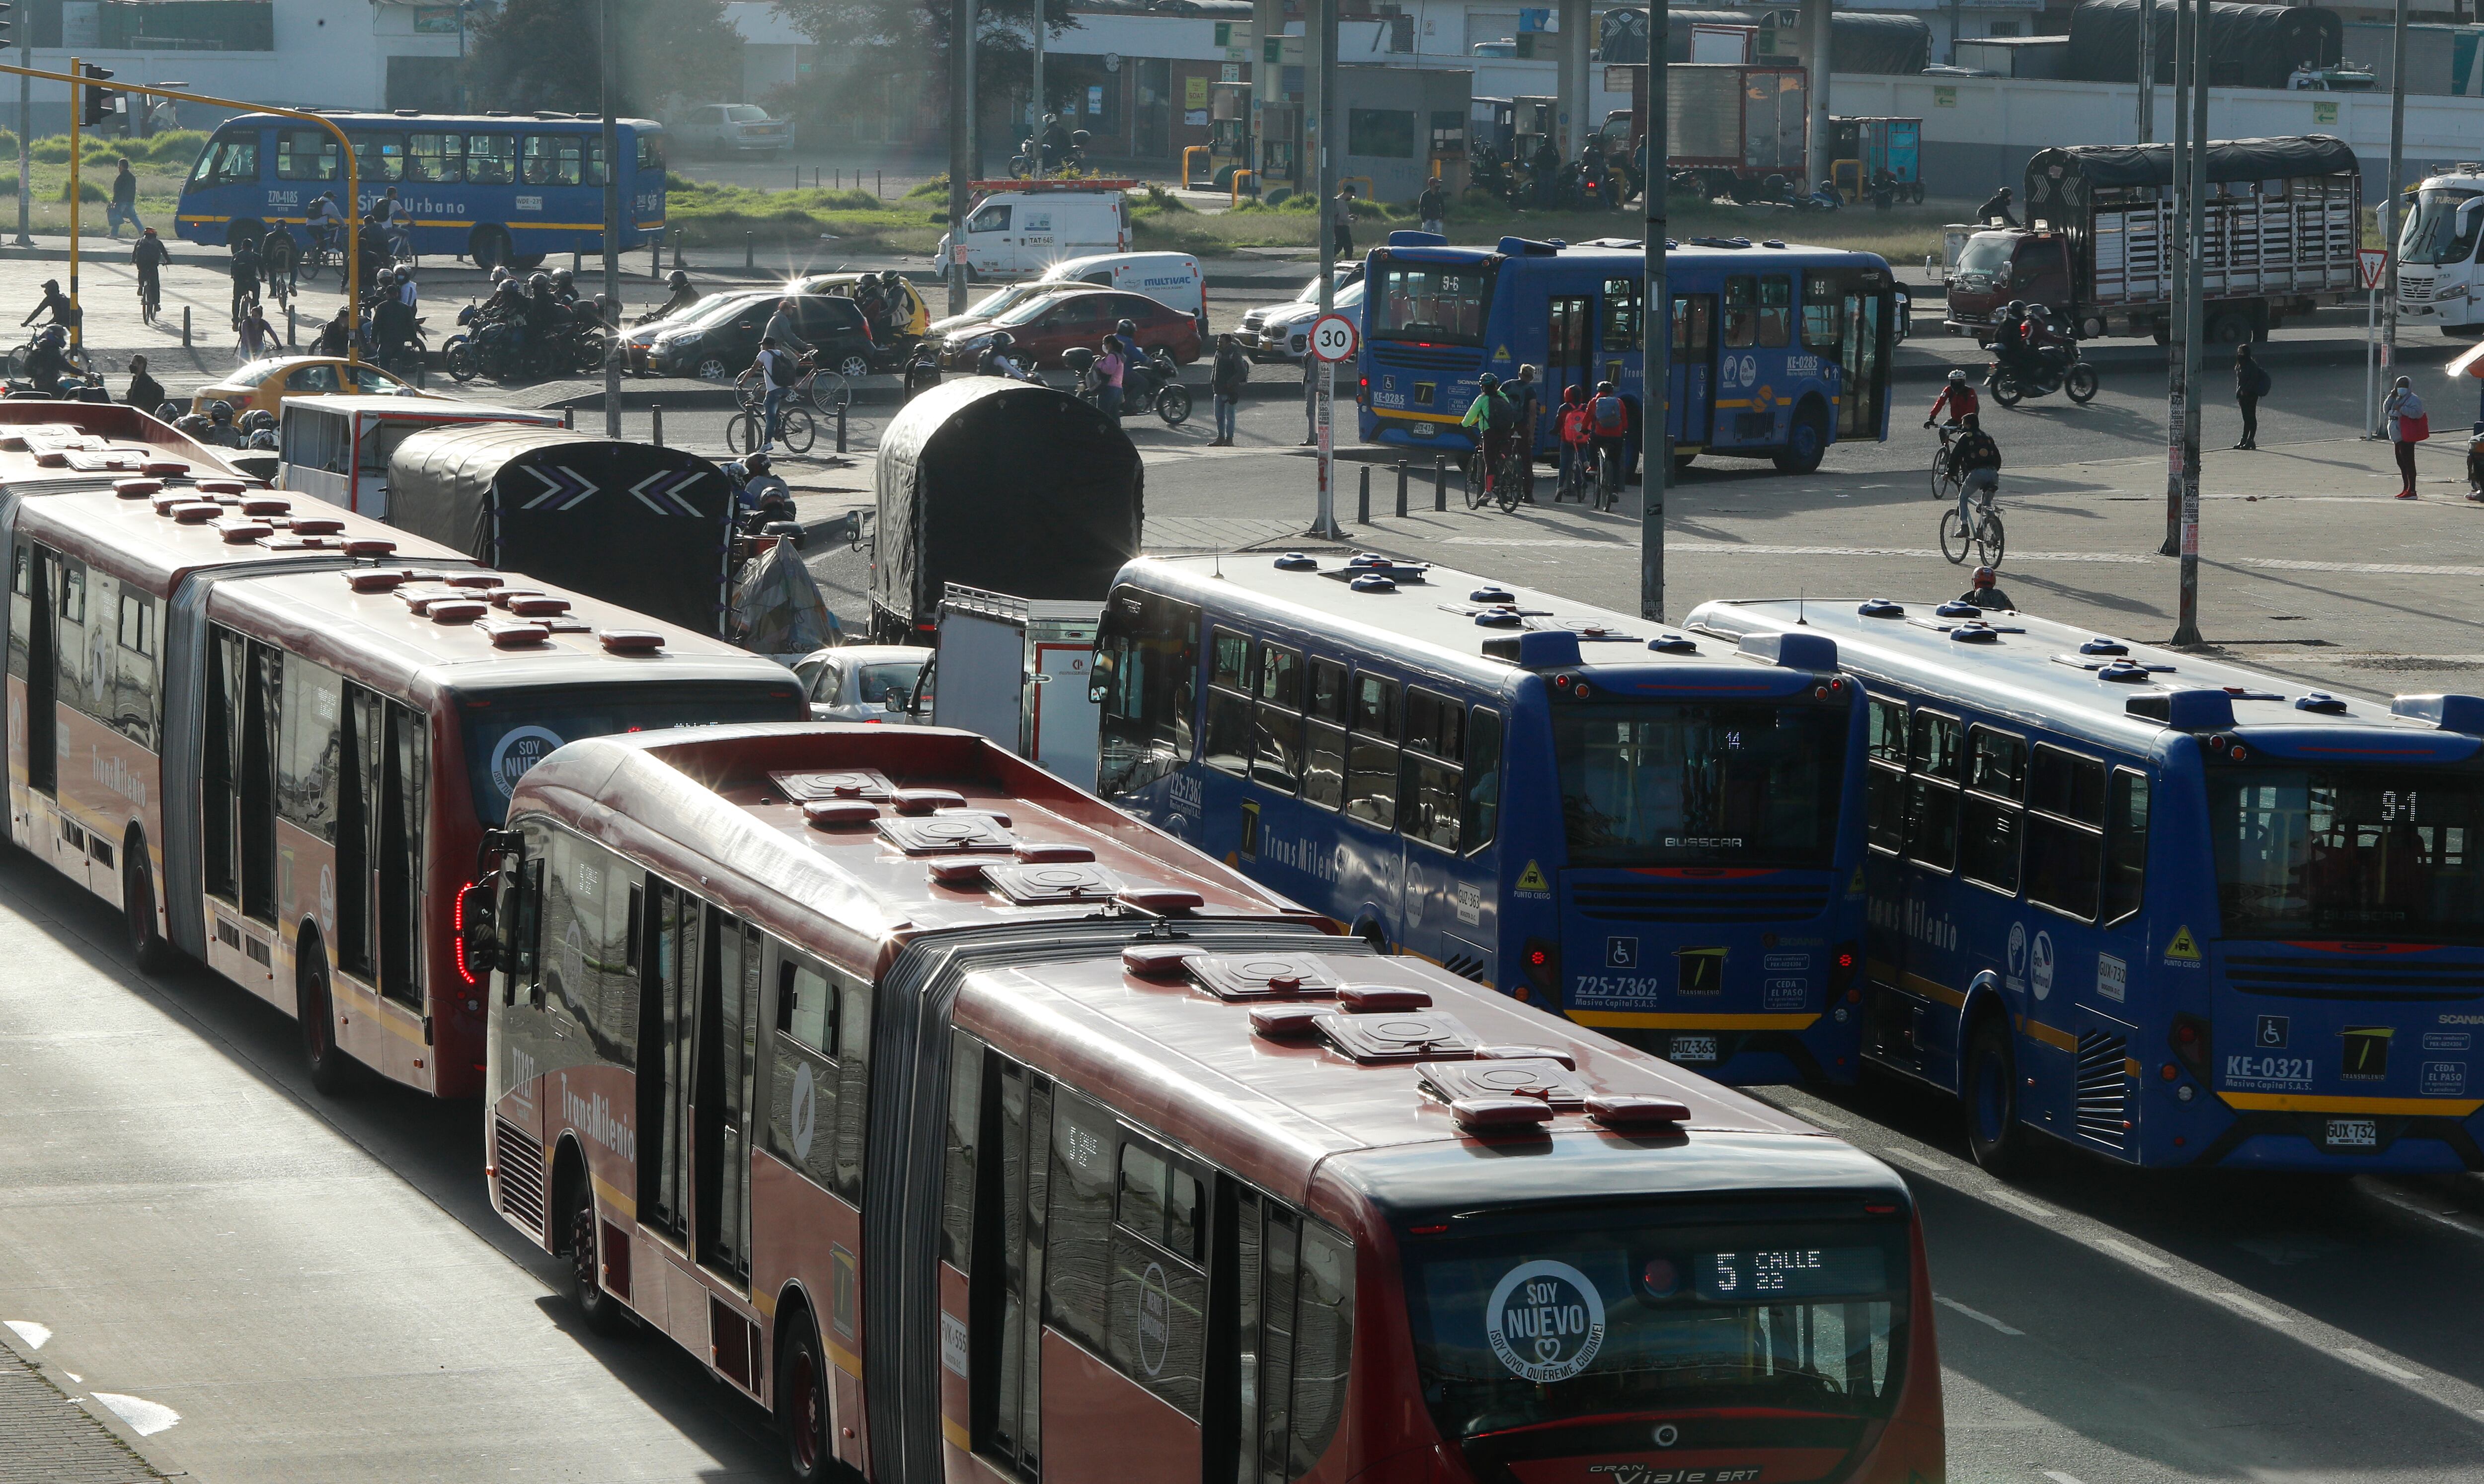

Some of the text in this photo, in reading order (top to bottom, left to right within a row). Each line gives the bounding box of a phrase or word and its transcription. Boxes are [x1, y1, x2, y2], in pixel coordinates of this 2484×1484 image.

[268, 191, 298, 204] Z70-4185
[403, 198, 465, 215] Urbano
[1145, 277, 1190, 286] MULTIVAC
[1443, 276, 1459, 291] 9-6
[1320, 330, 1346, 347] 30
[1787, 356, 1817, 369] KE-0285
[1374, 391, 1404, 403] KE-0285
[519, 741, 540, 755] SOY
[506, 756, 541, 777] NUE
[92, 744, 145, 808] TransMilenio
[1170, 771, 1202, 805] Z25-7362
[2381, 791, 2416, 821] 9-1
[1665, 837, 1742, 847] BUSSCAR
[1779, 938, 1824, 946] SCANIA
[1575, 976, 1657, 997] Z25-7362
[1605, 998, 1632, 1008] Capital
[2438, 1015, 2484, 1025] SCANIA
[512, 1046, 534, 1100] T1127
[2226, 1056, 2313, 1079] KE-0321
[2226, 1079, 2312, 1091] Masivo Capital S.A.S.
[561, 1072, 634, 1163] TransMilenio
[1717, 1251, 1820, 1290] 5 CALLE
[1756, 1272, 1783, 1289] 22
[1527, 1282, 1557, 1305] SOY
[1147, 1289, 1163, 1316] MENOS
[1507, 1305, 1584, 1338] NUEVO
[1490, 1323, 1603, 1380] ¡SOY TUYO, QUIÉREME, CUÍDAME!
[1615, 1470, 1759, 1484] Viale BRT
